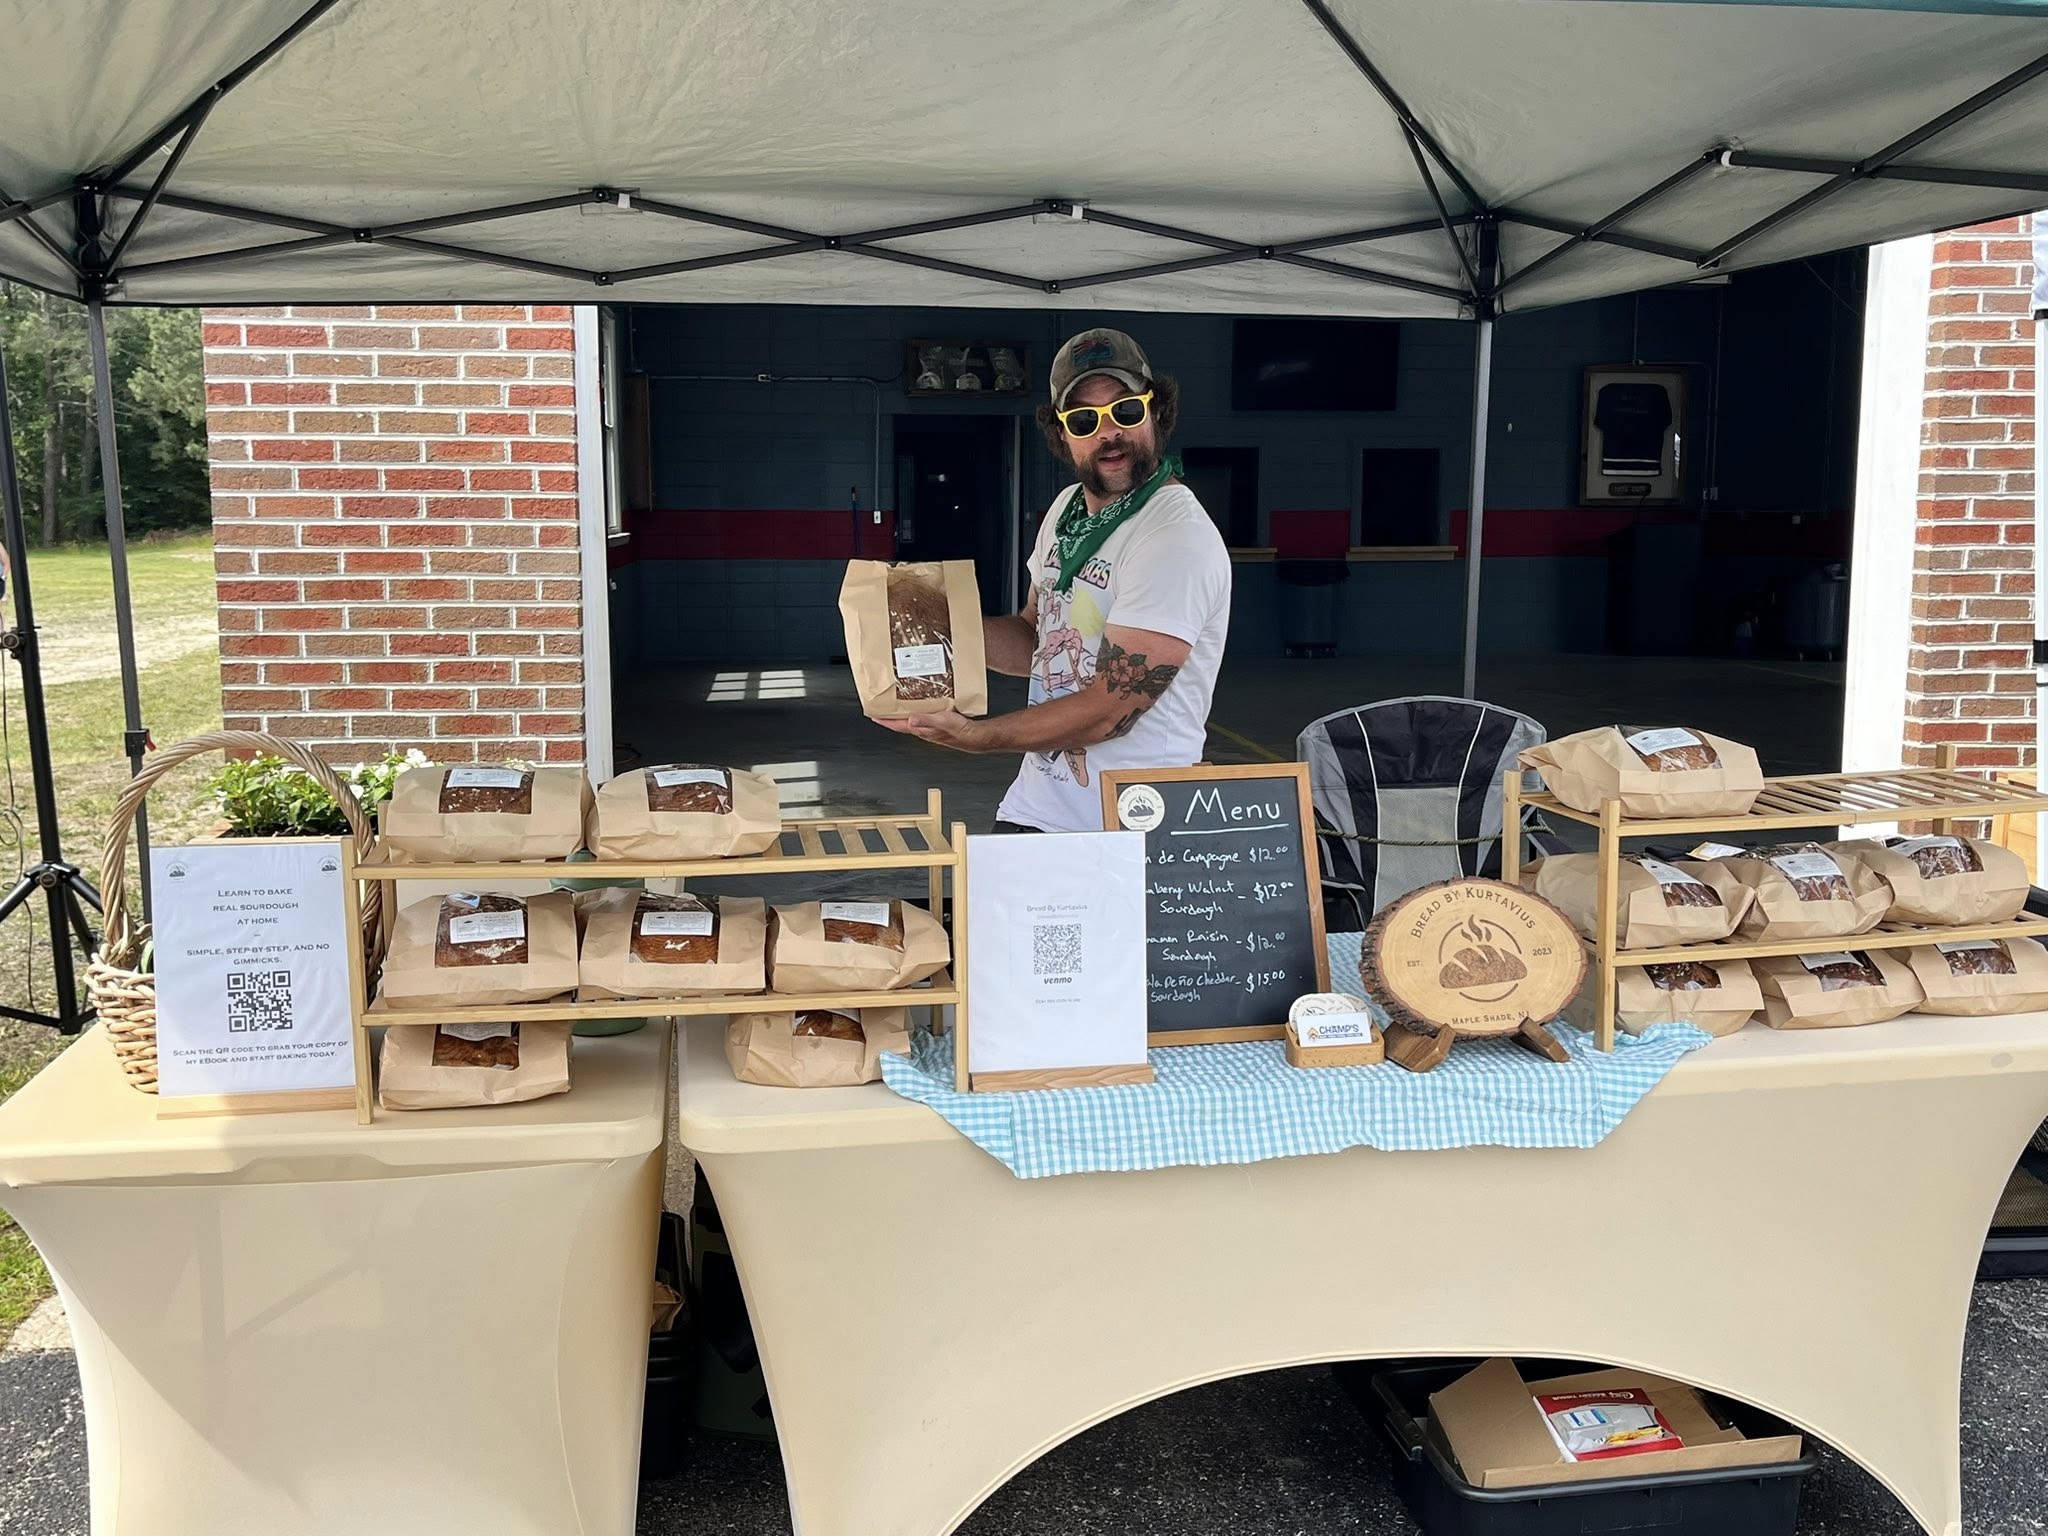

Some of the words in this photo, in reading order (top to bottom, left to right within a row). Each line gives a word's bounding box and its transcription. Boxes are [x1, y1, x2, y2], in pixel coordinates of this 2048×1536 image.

[1184, 787, 1281, 823] Menu
[1158, 850, 1175, 864] de
[1183, 848, 1242, 871] Campagne
[218, 889, 251, 897] LEARN
[267, 888, 293, 896] BAKE
[1187, 880, 1235, 894] Walnut
[213, 904, 238, 912] REAL
[240, 902, 299, 911] SOURDOUGH
[1159, 901, 1224, 921] Sourdough
[1411, 900, 1441, 938] BREAD
[1443, 890, 1460, 903] BY
[1465, 887, 1537, 930] KURTAVIUS
[251, 917, 279, 925] HOME
[1186, 929, 1229, 944] Raisin
[186, 947, 224, 956] SIMPLE,
[1532, 948, 1553, 957] 2023
[233, 956, 283, 966] GIMMICKS.
[1162, 948, 1217, 971] Sourdough
[1406, 960, 1423, 968] EST.
[1044, 976, 1072, 985] venmo
[1196, 972, 1236, 986] Cheddar
[1245, 969, 1286, 994] $15.00
[1151, 989, 1201, 1003] Sourdough
[1452, 1016, 1481, 1025] MAPLE
[1483, 1013, 1516, 1023] SHADE,
[1319, 1024, 1360, 1035] CHAMP'S
